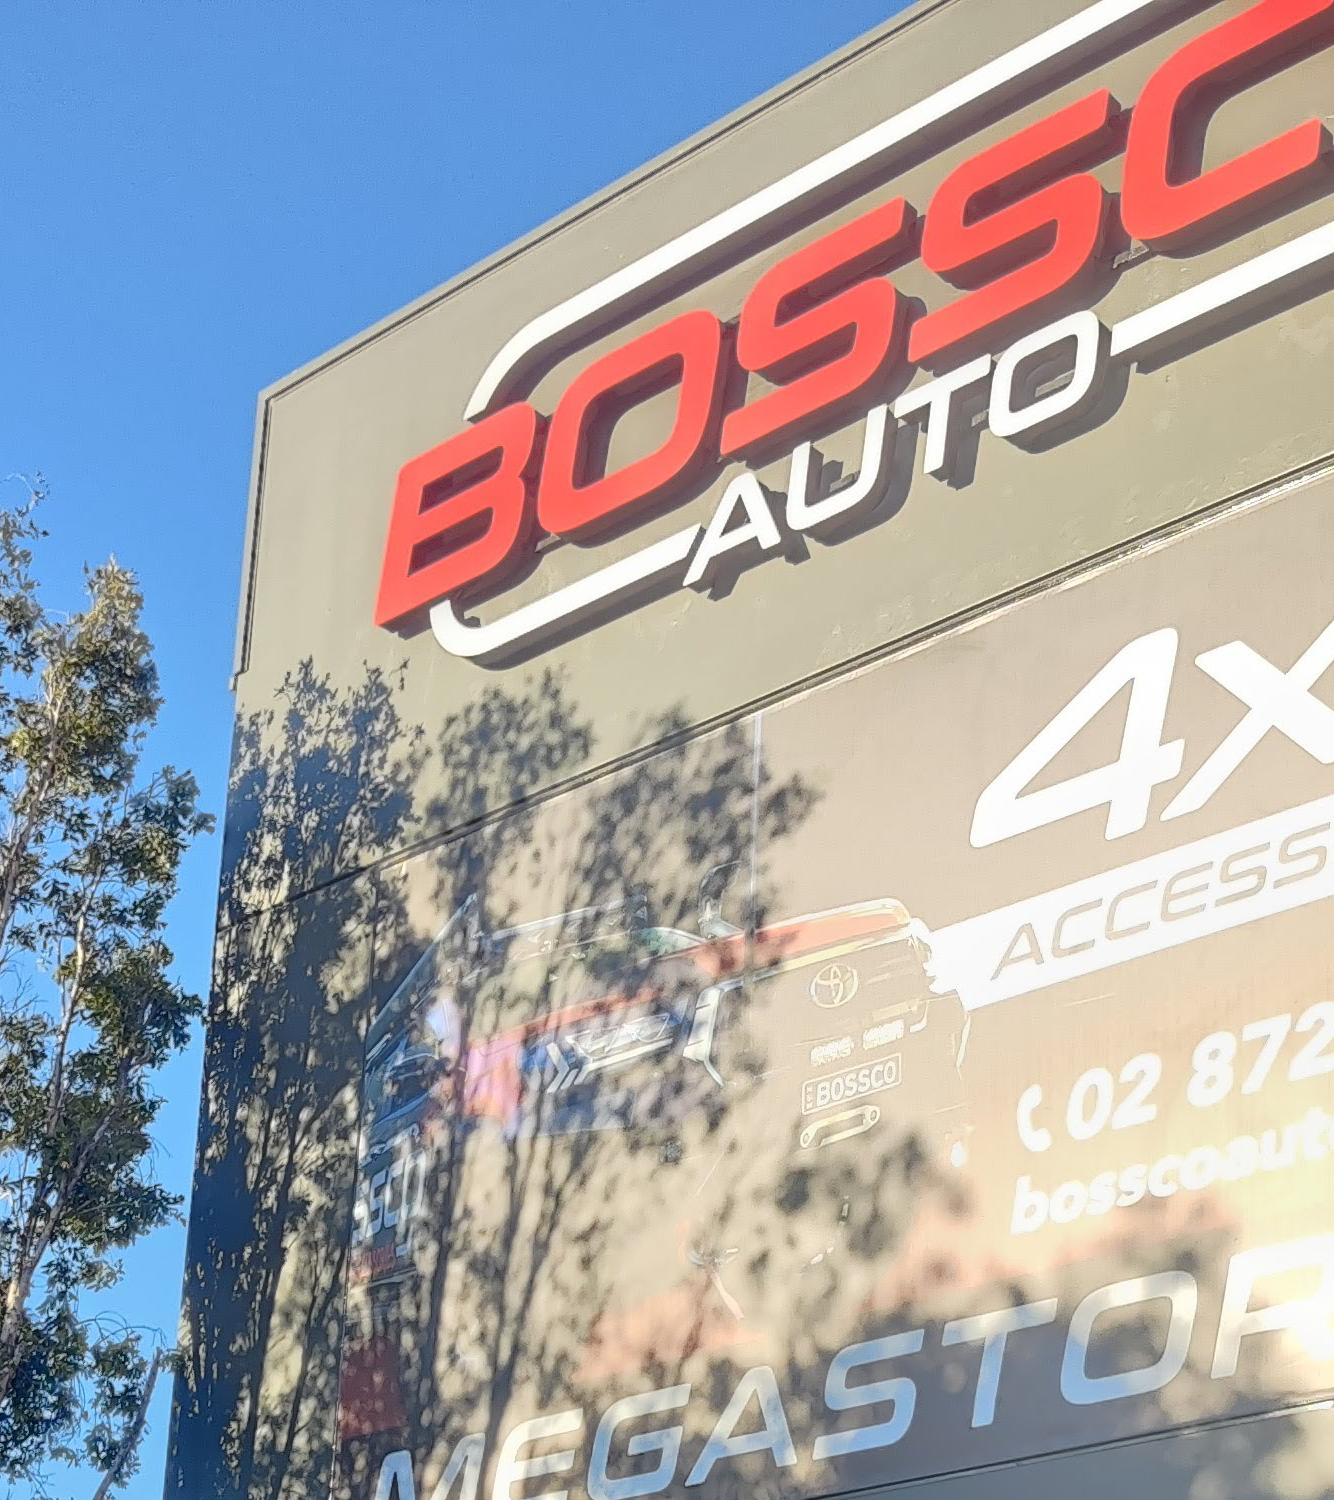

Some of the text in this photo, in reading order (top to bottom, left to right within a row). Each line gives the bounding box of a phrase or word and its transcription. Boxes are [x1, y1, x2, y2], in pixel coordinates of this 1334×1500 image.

[684, 310, 1101, 588] AUTO
[816, 1060, 897, 1107] BOSSCO
[1066, 1053, 1163, 1141] 02
